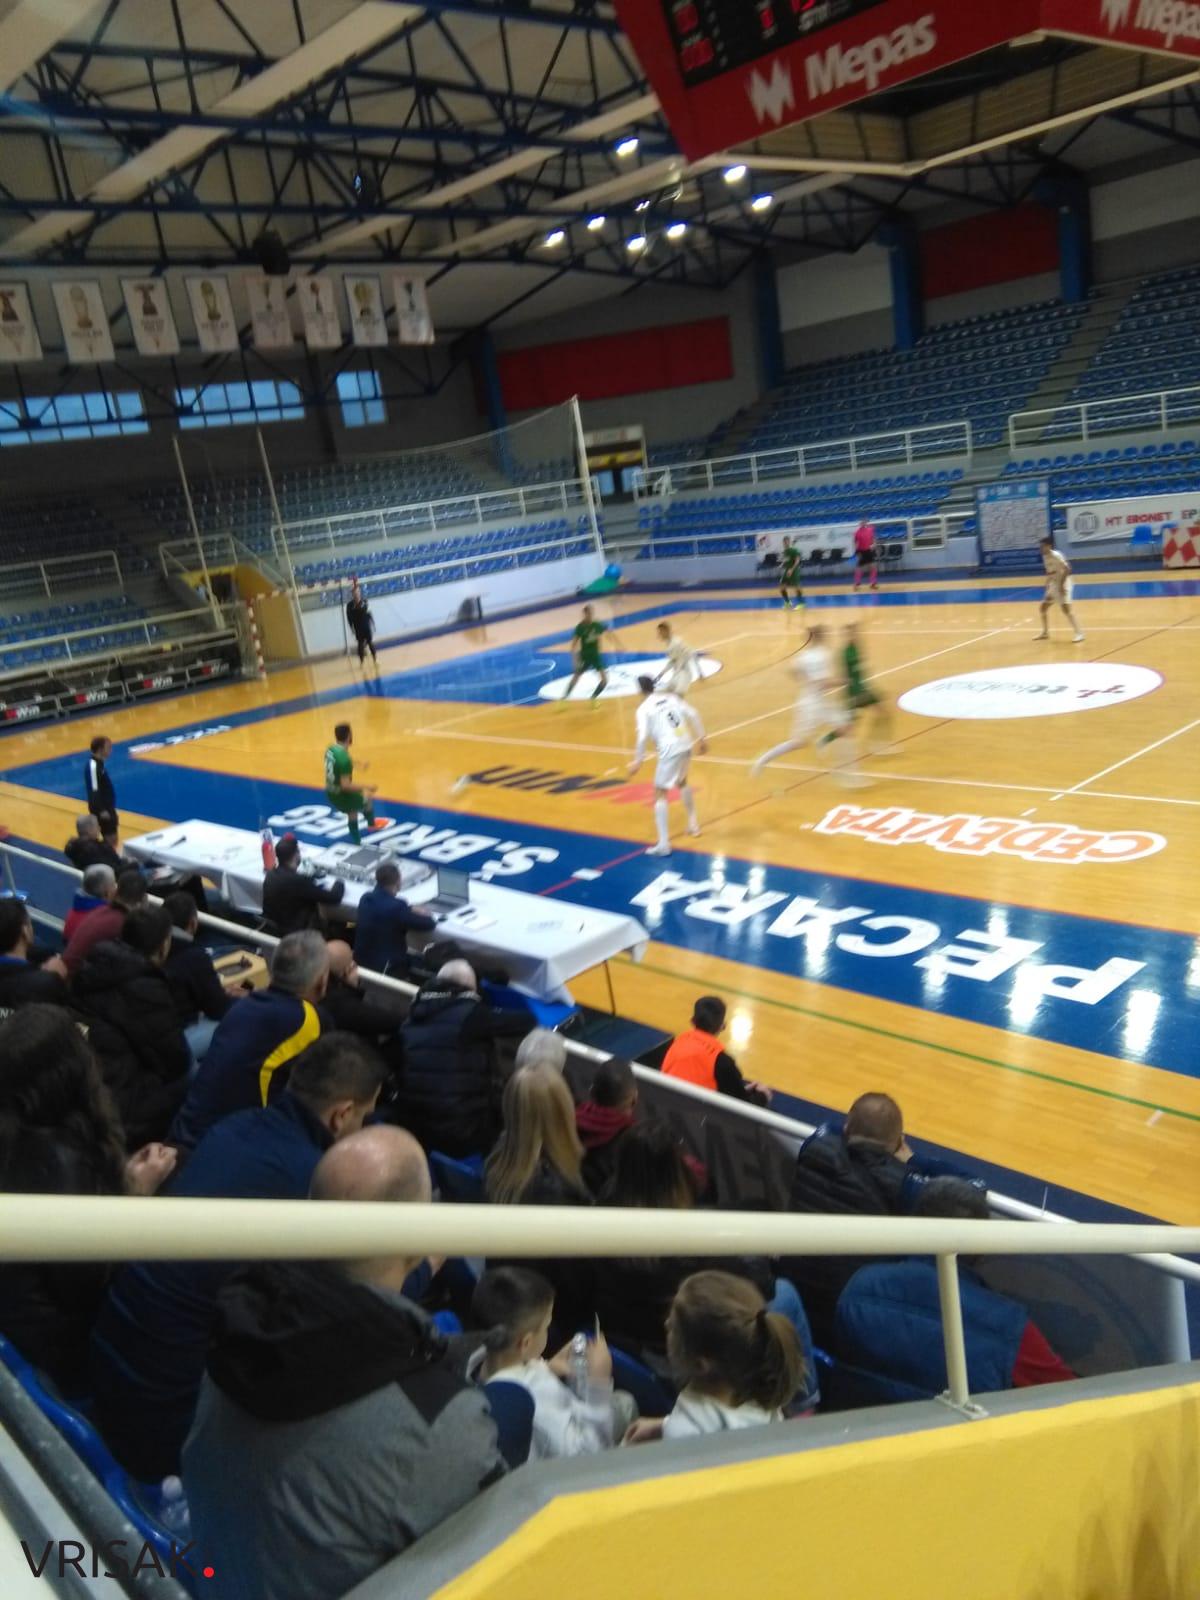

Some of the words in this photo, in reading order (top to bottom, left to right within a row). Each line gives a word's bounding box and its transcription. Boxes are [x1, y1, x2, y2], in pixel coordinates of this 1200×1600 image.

[805, 13, 938, 101] Mepas
[813, 804, 1168, 864] CEDEVITA
[629, 871, 1148, 1005] PECARA
